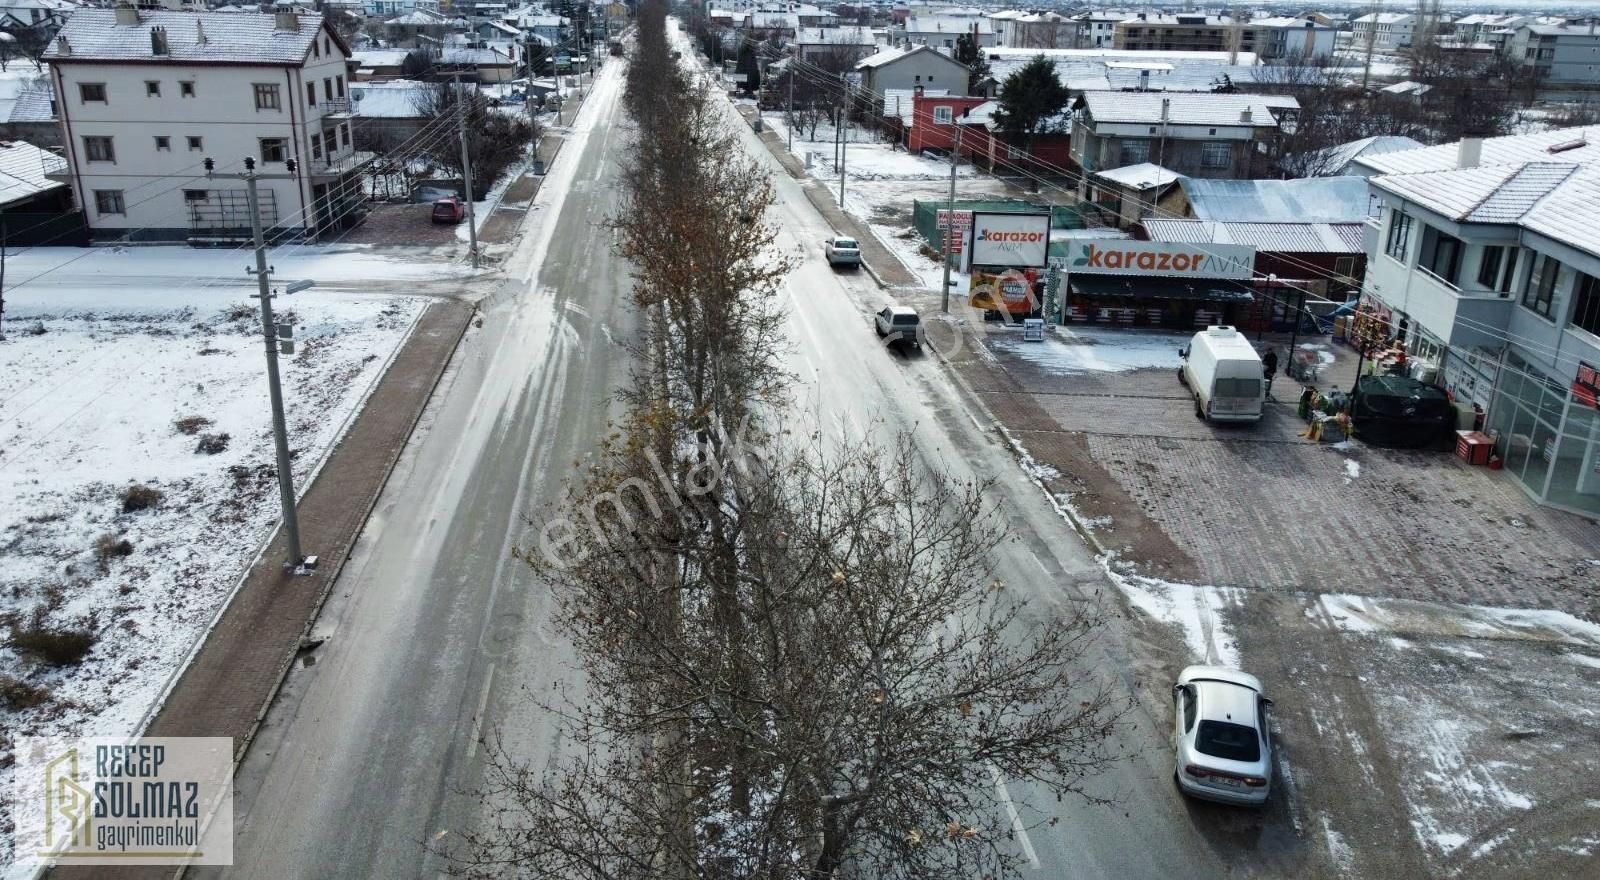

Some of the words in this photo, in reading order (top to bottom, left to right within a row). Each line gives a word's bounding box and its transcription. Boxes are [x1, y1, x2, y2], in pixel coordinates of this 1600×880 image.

[985, 231, 1044, 242] karazor
[1088, 244, 1203, 271] karazor
[1203, 255, 1250, 273] AVM
